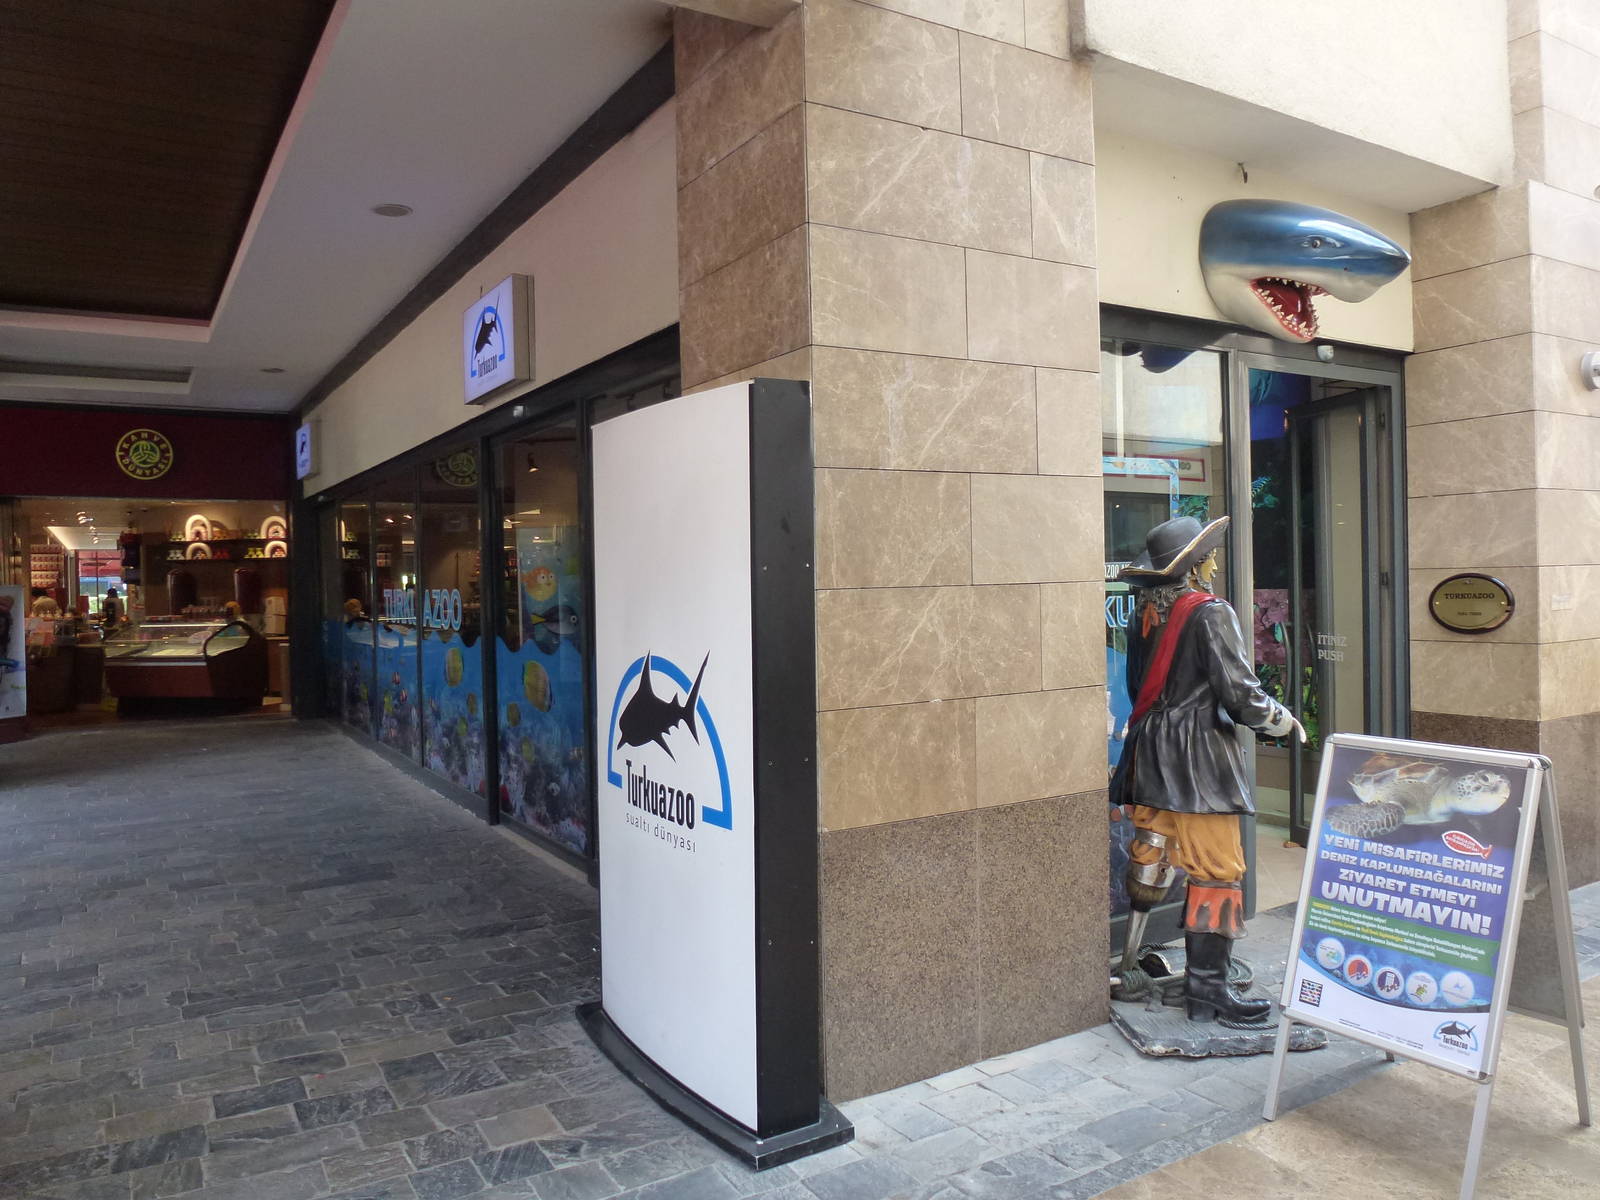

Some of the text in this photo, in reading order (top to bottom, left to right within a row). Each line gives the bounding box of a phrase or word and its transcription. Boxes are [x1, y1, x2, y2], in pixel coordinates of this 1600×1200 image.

[122, 431, 168, 449] KAHVE
[1443, 592, 1495, 600] TURKUAZOO
[1317, 649, 1345, 662] PUSH
[625, 759, 695, 830] Turkuazoo
[654, 823, 696, 853] dünyası
[1321, 880, 1492, 936] UNUTMAYIN!
